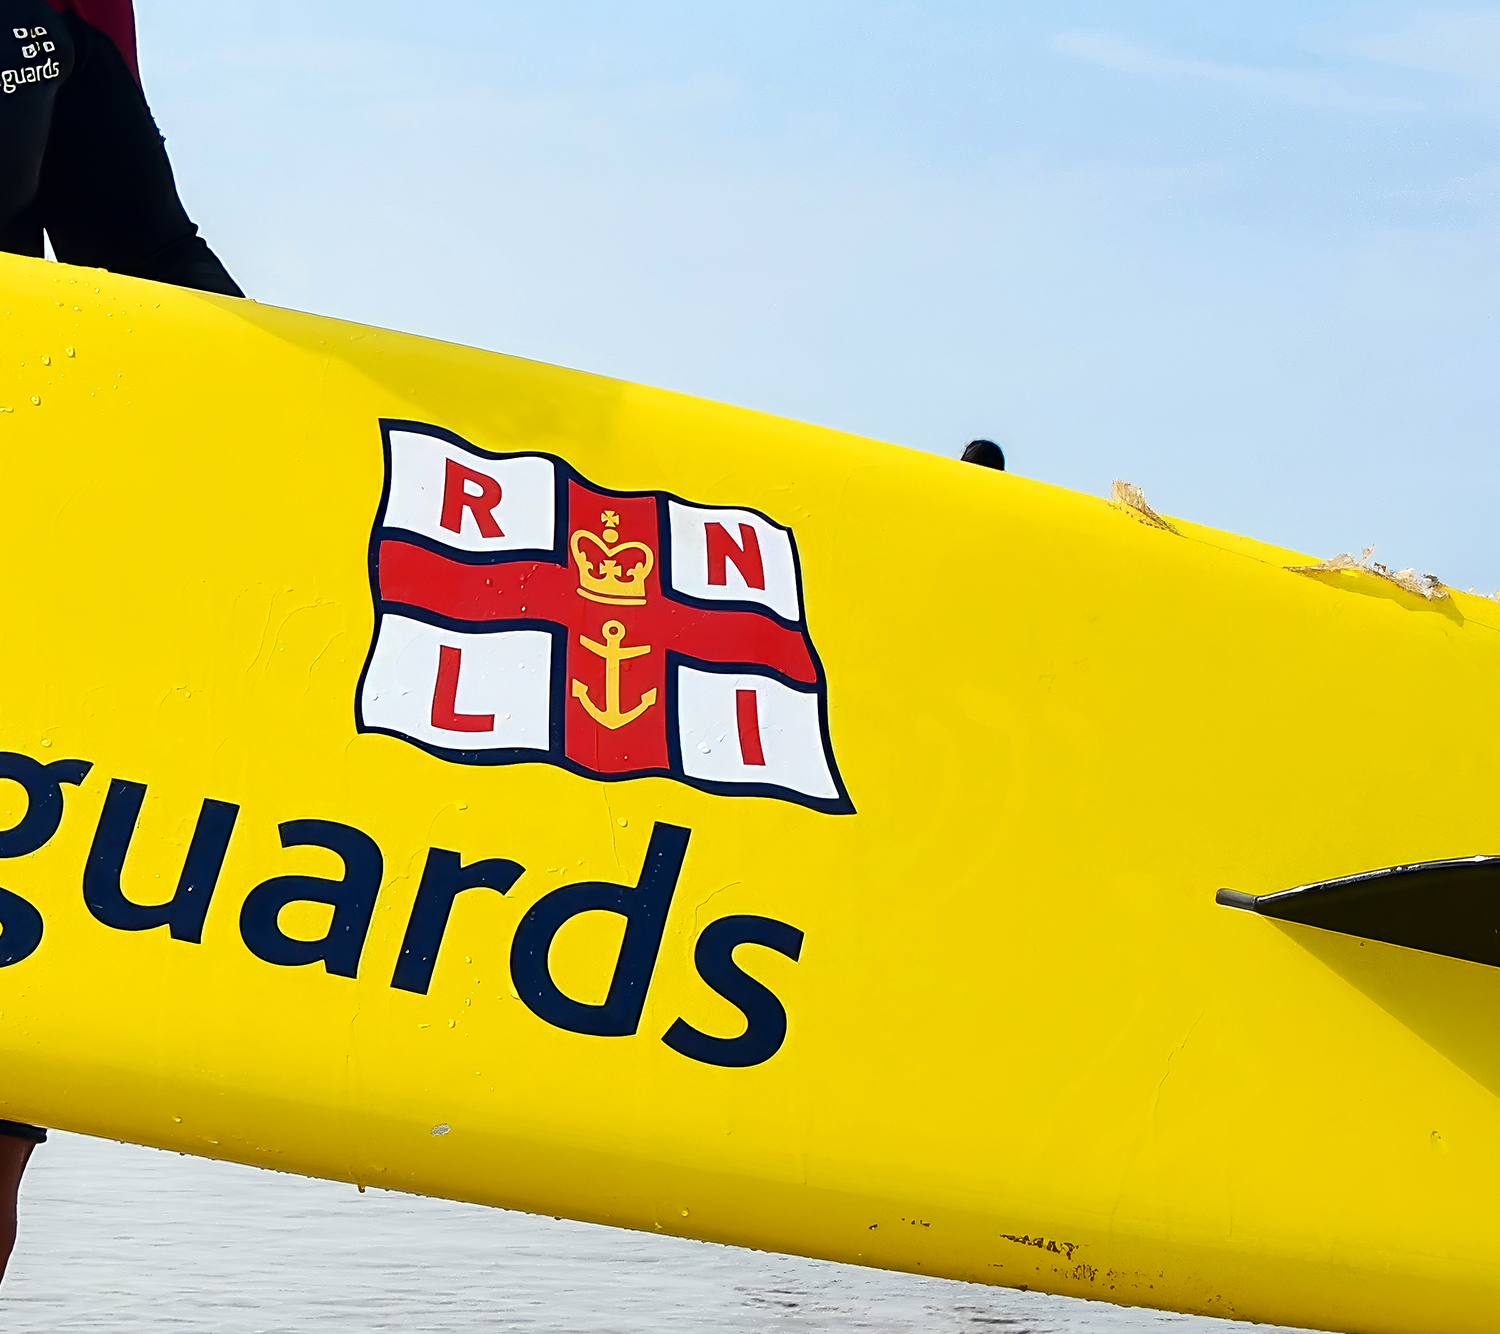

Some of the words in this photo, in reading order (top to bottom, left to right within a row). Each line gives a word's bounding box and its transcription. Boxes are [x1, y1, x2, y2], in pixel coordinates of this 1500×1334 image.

[440, 458, 504, 539] R
[705, 523, 765, 590] N
[431, 645, 495, 733] L
